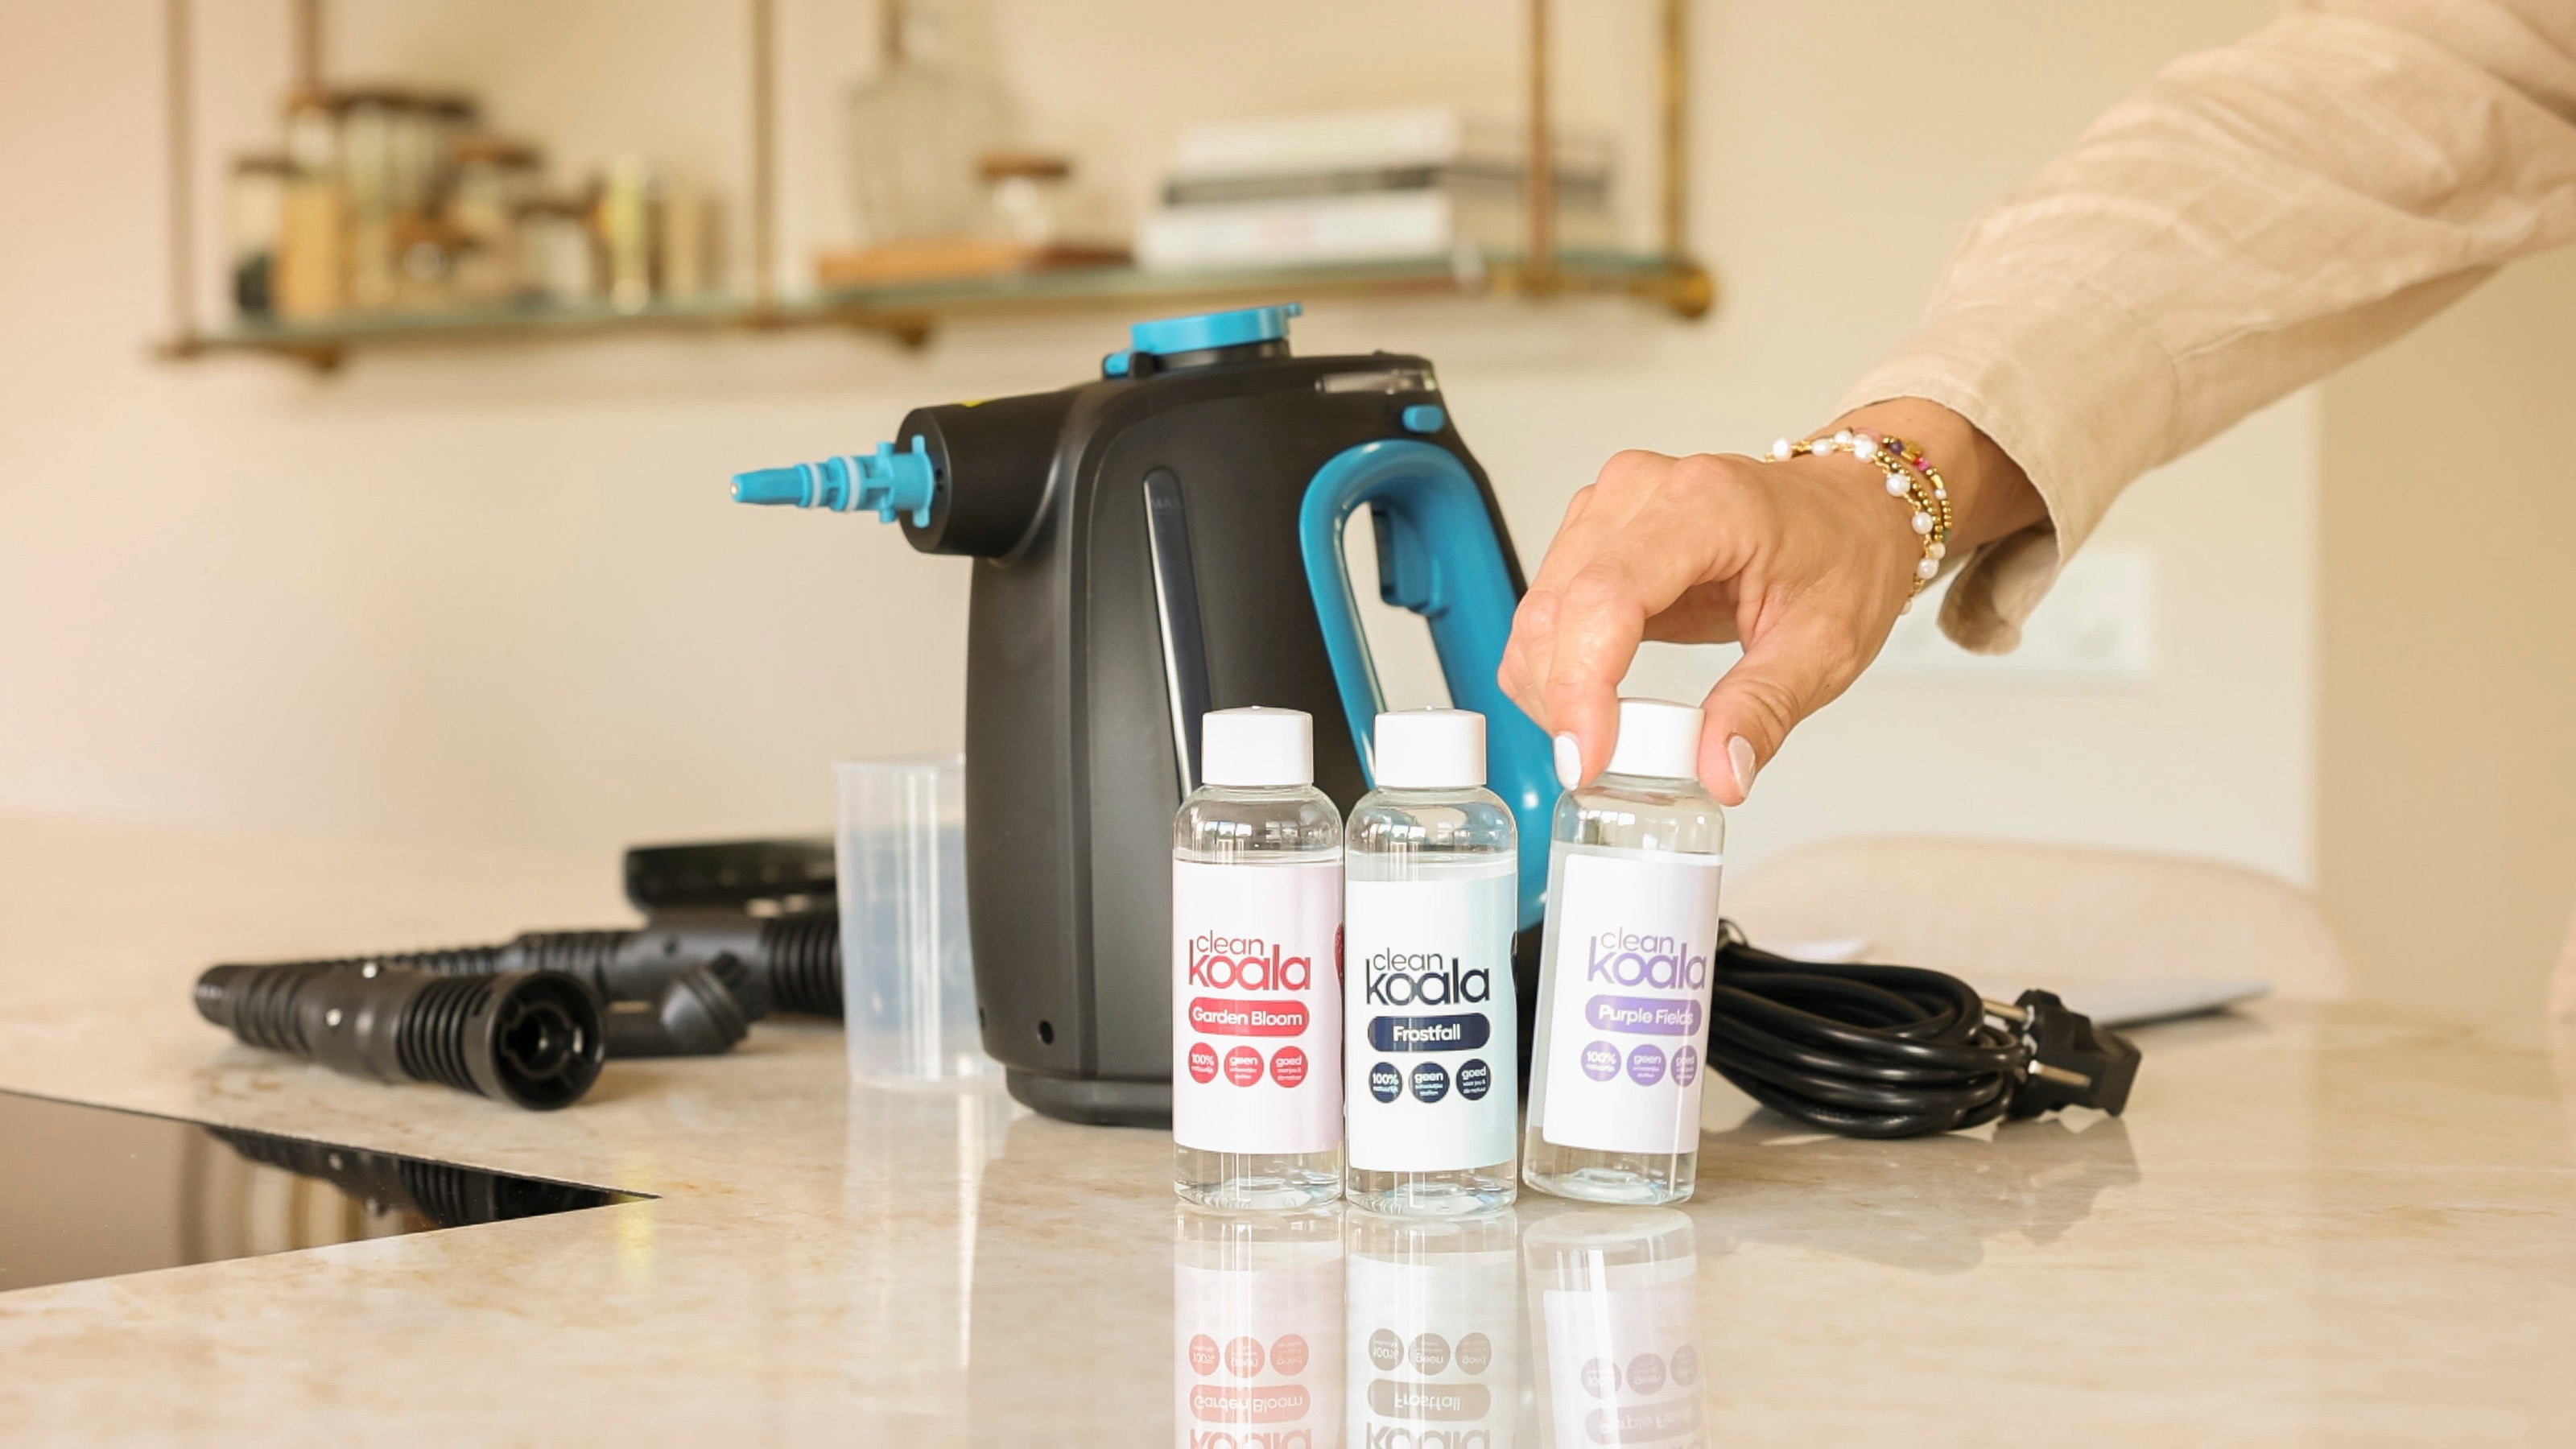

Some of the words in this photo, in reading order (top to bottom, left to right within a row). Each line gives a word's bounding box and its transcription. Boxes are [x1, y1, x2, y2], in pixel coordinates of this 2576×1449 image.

[1196, 930, 1264, 956] clean
[1601, 927, 1674, 954] clean
[1188, 939, 1311, 991] koala
[1373, 947, 1443, 972] clean
[1587, 935, 1708, 990] koala
[1365, 957, 1490, 1006] koala
[1192, 1006, 1249, 1025] Garden
[1251, 1010, 1303, 1026] Bloom
[1598, 1004, 1653, 1026] Purple
[1655, 1008, 1694, 1026] Fields
[1393, 1023, 1461, 1042] Frostfall
[1191, 1053, 1214, 1066] 100%
[1229, 1056, 1258, 1067] geen
[1275, 1055, 1302, 1067] goed
[1587, 1050, 1616, 1065] 100%
[1372, 1072, 1399, 1085] 100%
[1414, 1072, 1443, 1084] geen
[1461, 1066, 1486, 1080] goed
